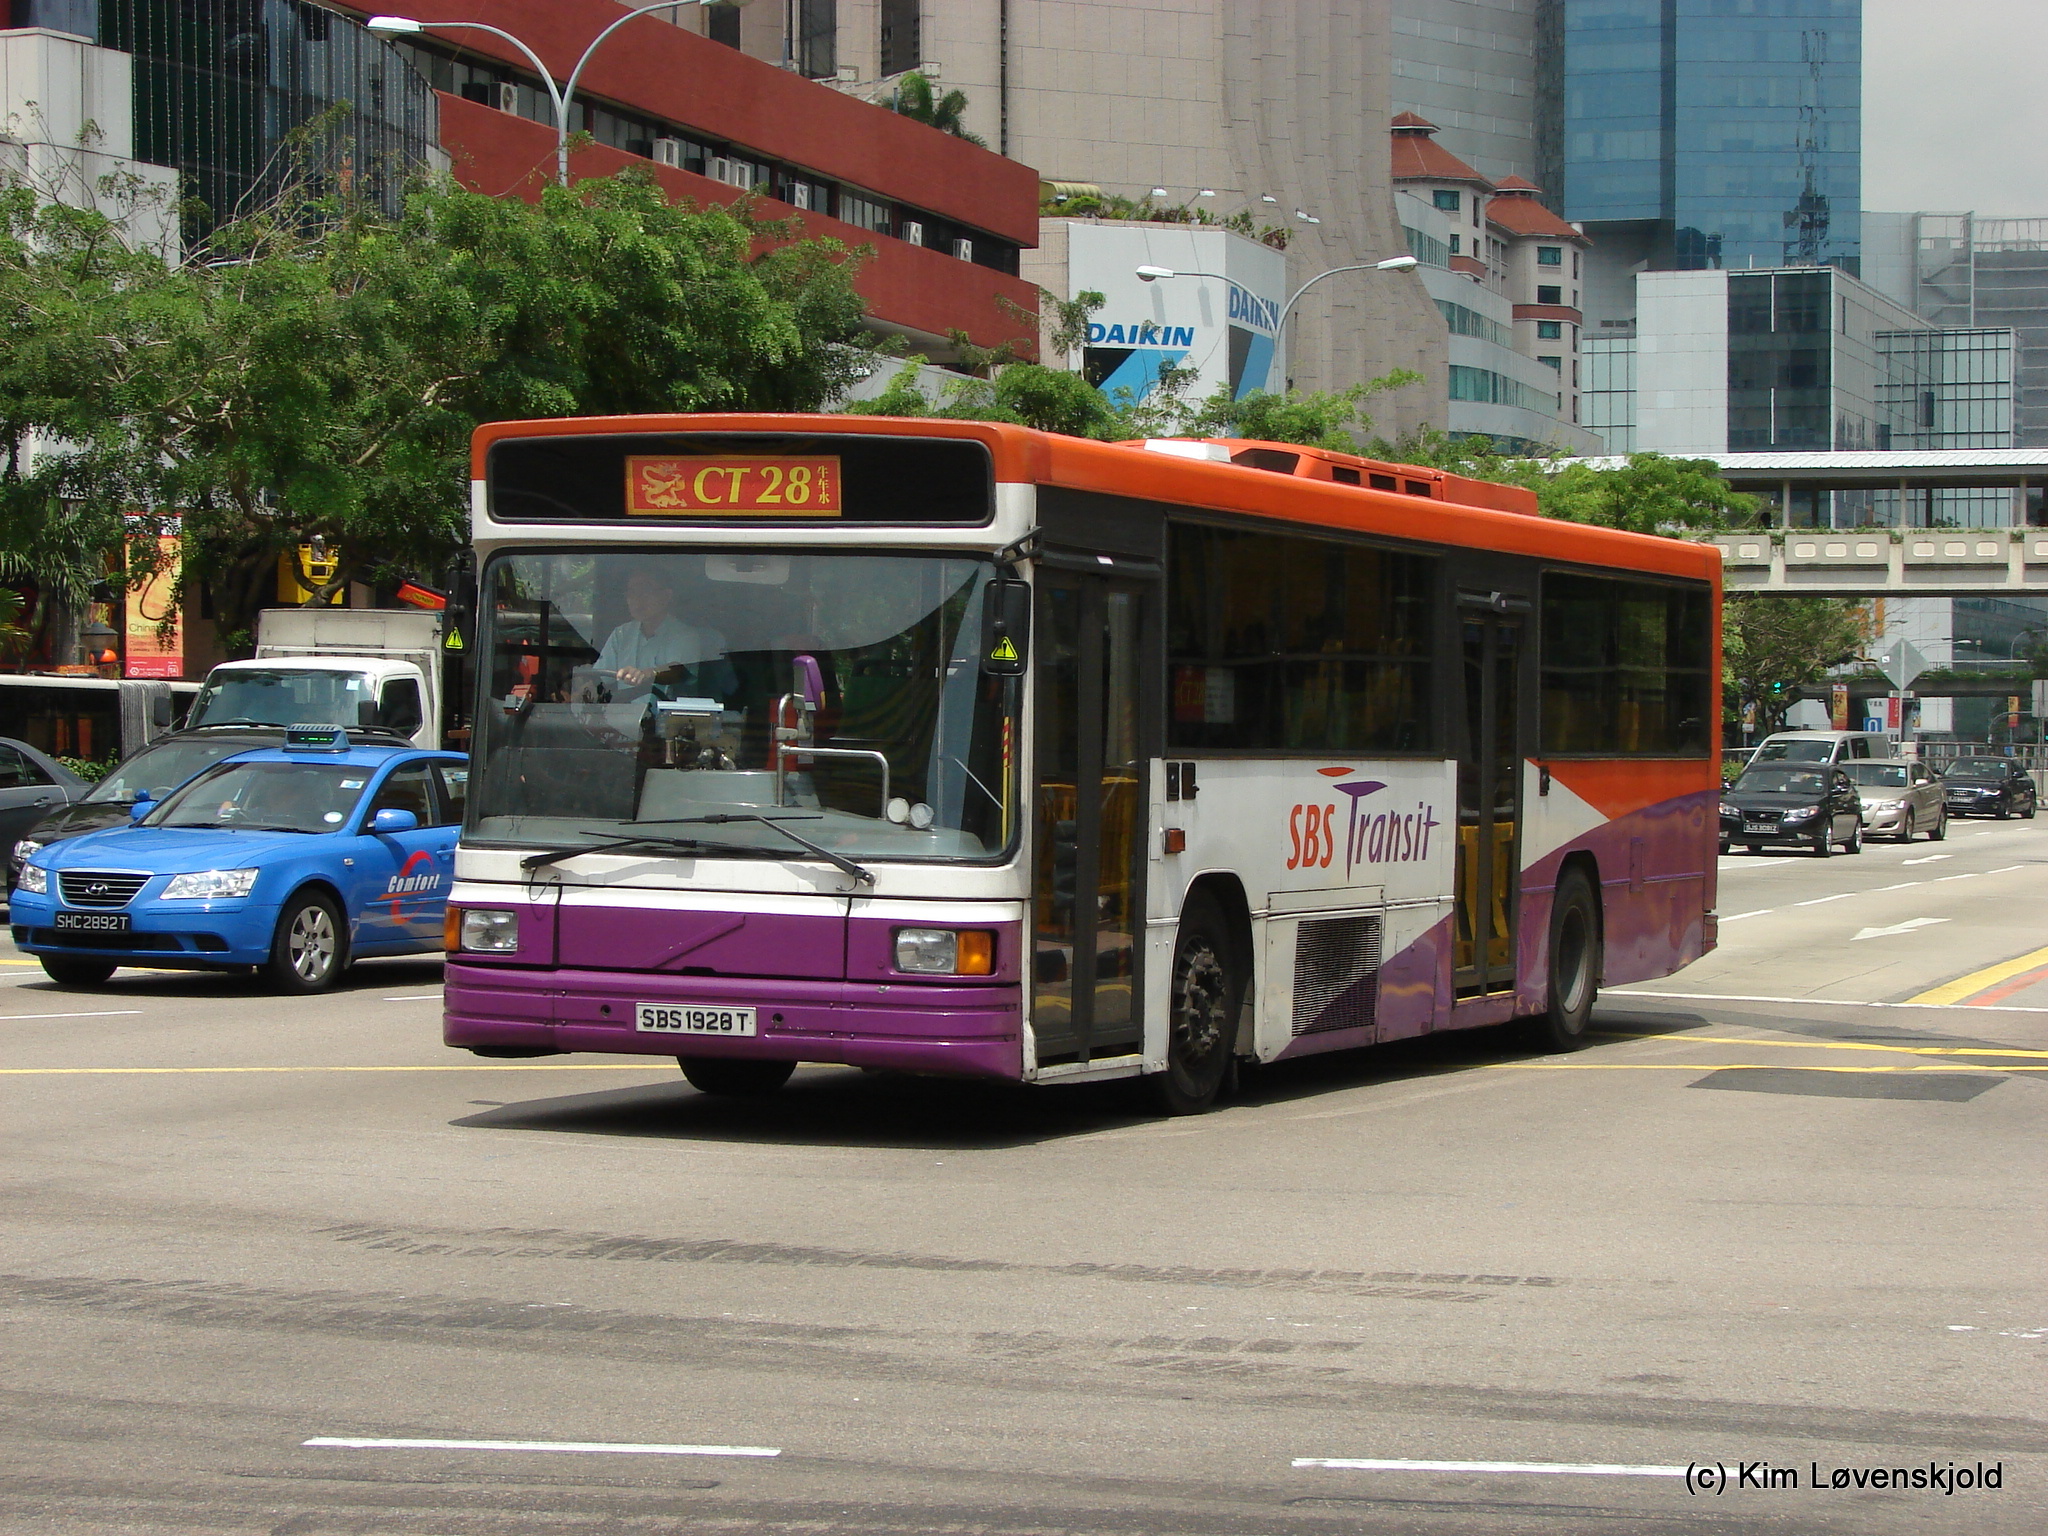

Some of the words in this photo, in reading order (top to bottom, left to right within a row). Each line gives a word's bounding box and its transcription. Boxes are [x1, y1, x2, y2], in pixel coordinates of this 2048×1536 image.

[1229, 286, 1279, 331] DAIKIN
[1087, 323, 1194, 346] DAIKIN
[694, 466, 750, 504] CT
[755, 466, 811, 504] 28
[1287, 804, 1335, 870] SBS
[1332, 781, 1441, 883] Transit
[387, 874, 440, 893] Comfort
[57, 914, 128, 930] SHC2892T
[642, 1008, 748, 1031] SBS1928T
